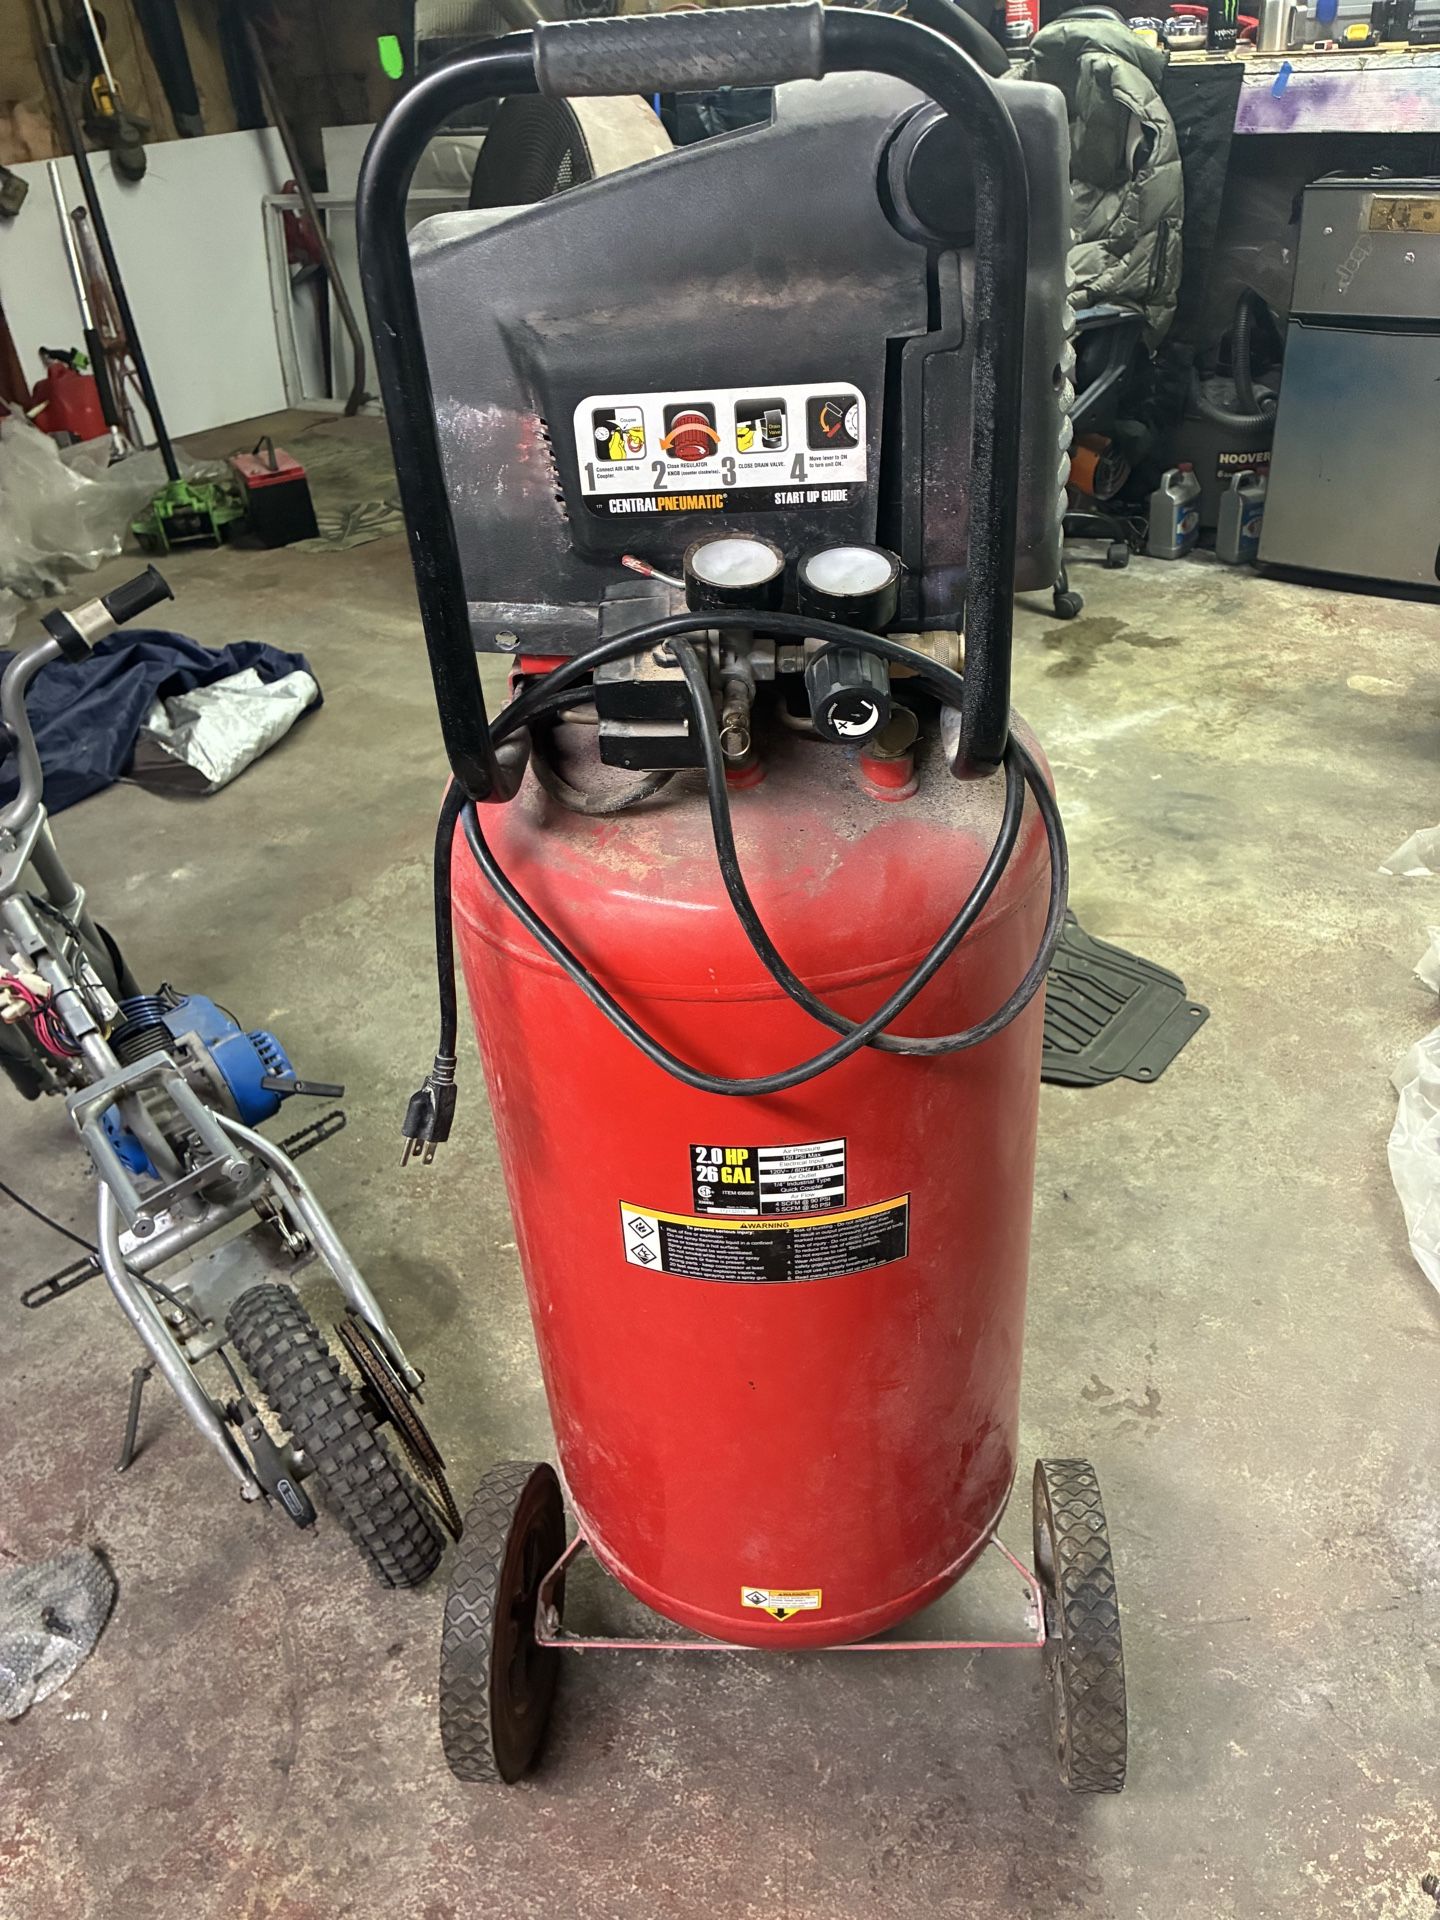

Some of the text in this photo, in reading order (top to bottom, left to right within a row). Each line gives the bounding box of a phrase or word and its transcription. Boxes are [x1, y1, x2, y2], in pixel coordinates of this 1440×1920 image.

[1219, 451, 1270, 464] HOOVER
[584, 462, 596, 491] 1
[652, 460, 668, 490] 2
[722, 456, 736, 486] 3
[790, 453, 808, 482] 4
[775, 491, 805, 505] START
[806, 490, 819, 503] UP
[822, 489, 848, 502] GUIDE
[695, 1147, 748, 1165] 2.0 HP
[696, 1165, 755, 1184] 26 GAL
[787, 1178, 814, 1186] Industrial
